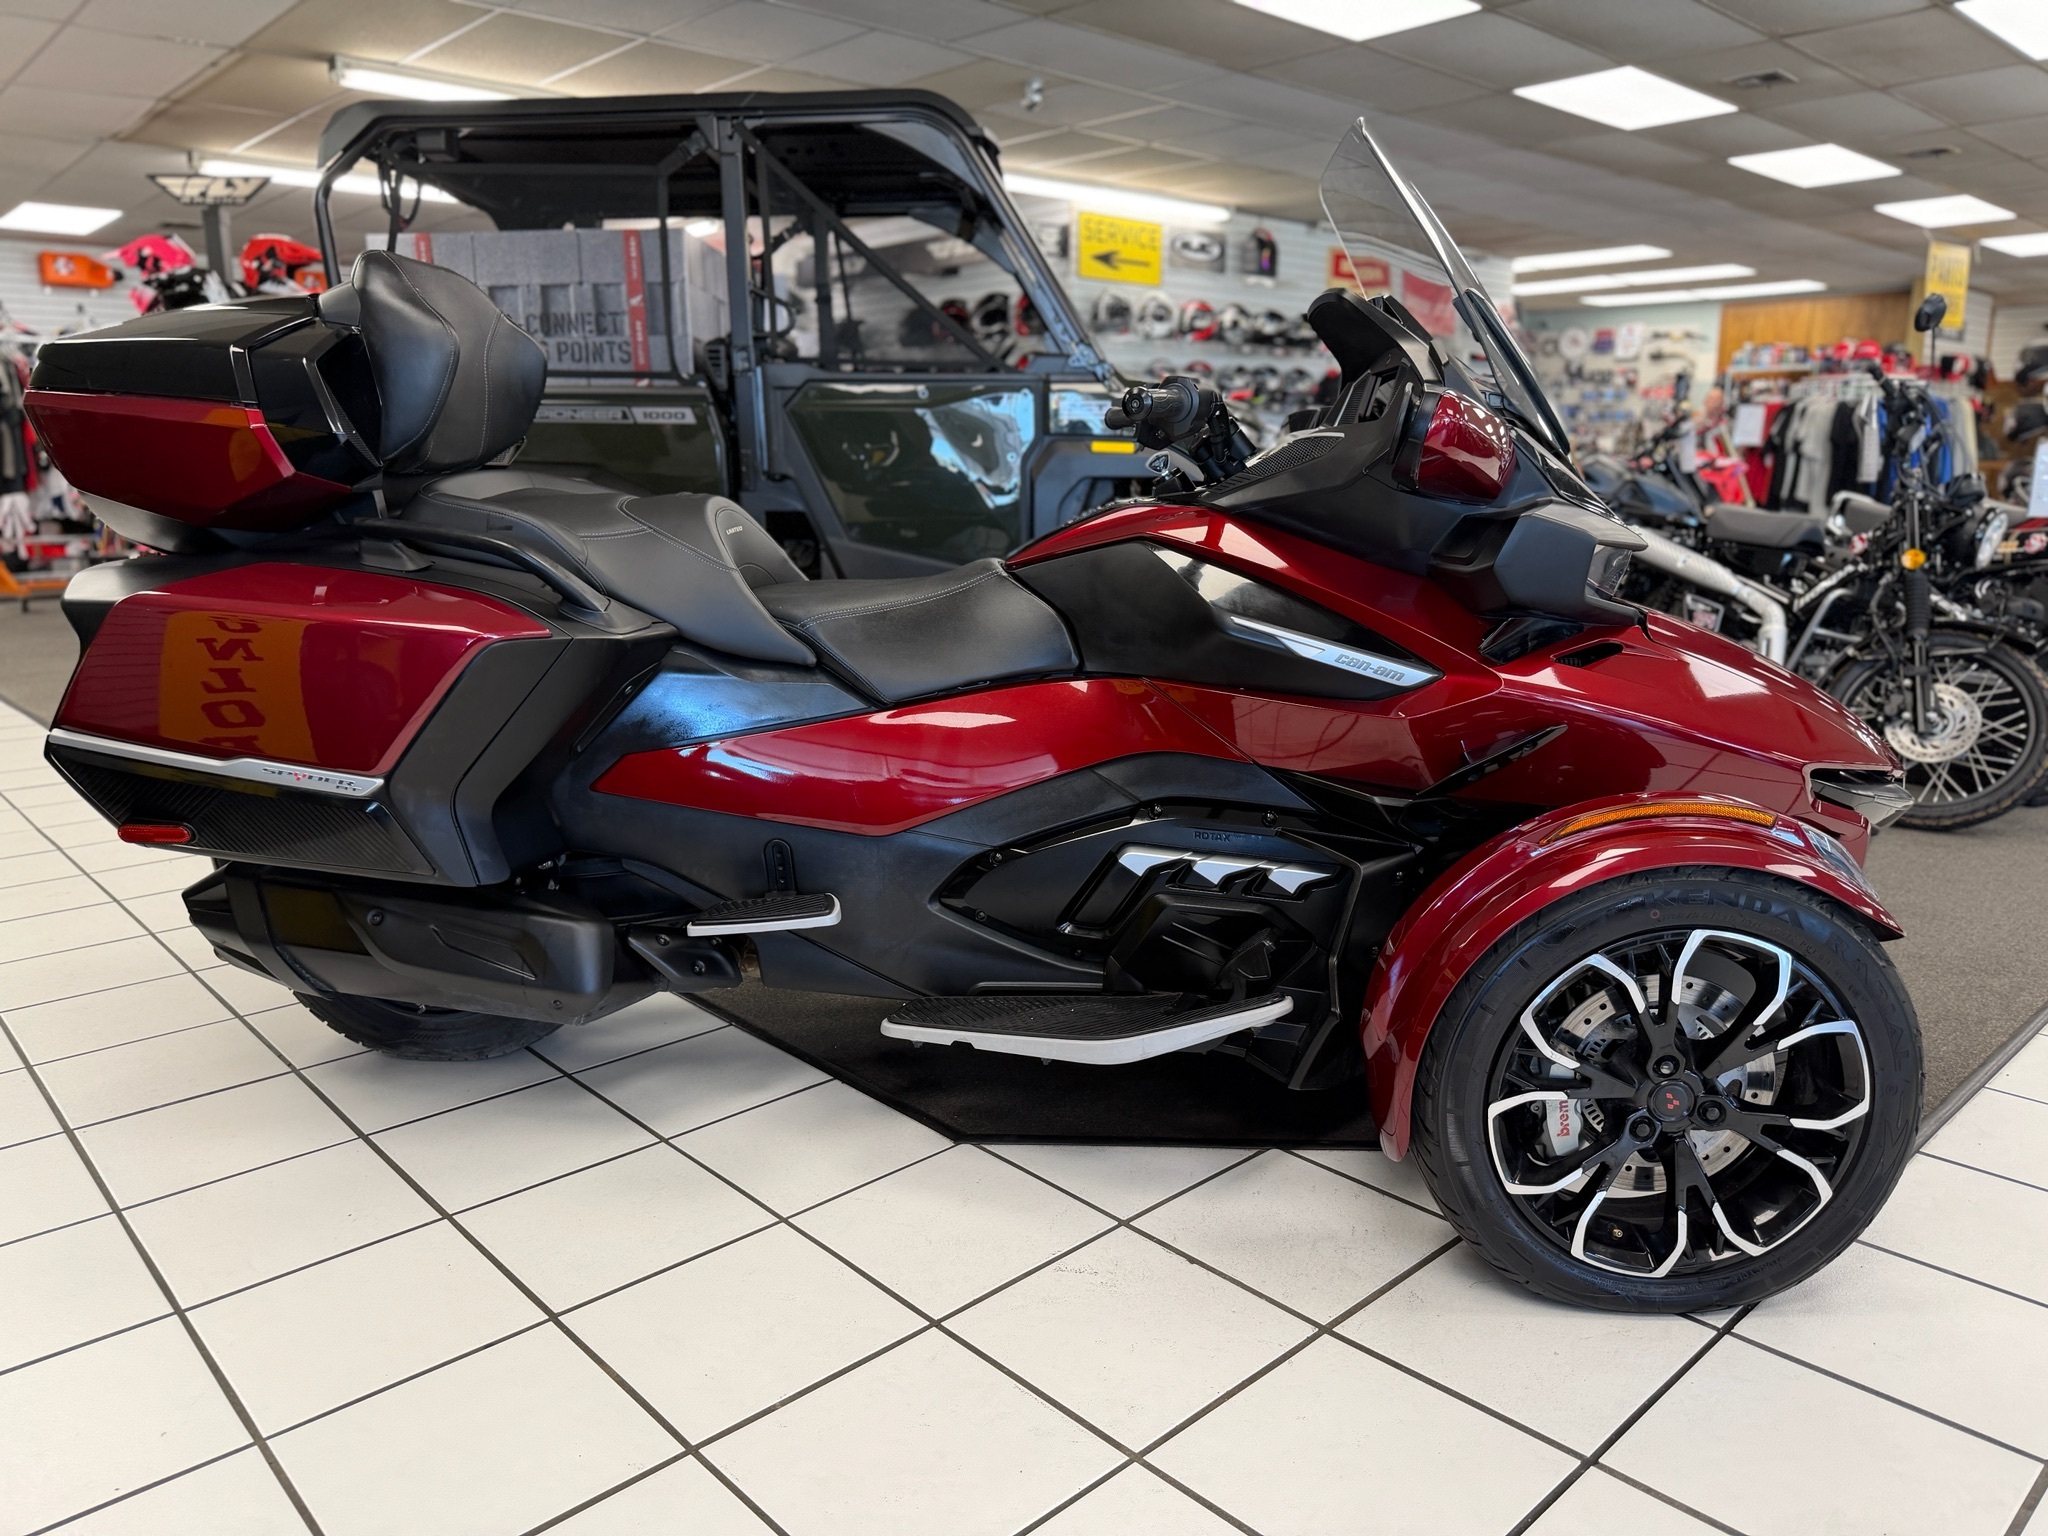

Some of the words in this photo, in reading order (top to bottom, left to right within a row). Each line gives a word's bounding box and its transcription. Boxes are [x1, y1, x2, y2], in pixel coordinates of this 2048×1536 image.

[1084, 217, 1160, 252] SERVICE
[556, 340, 632, 364] POINTS
[642, 410, 686, 421] 1000
[1334, 652, 1405, 682] can-am
[262, 768, 355, 786] SPYDER
[1194, 831, 1231, 842] ROTAX
[1647, 888, 1806, 929] KENDA
[1556, 1100, 1571, 1137] brem
